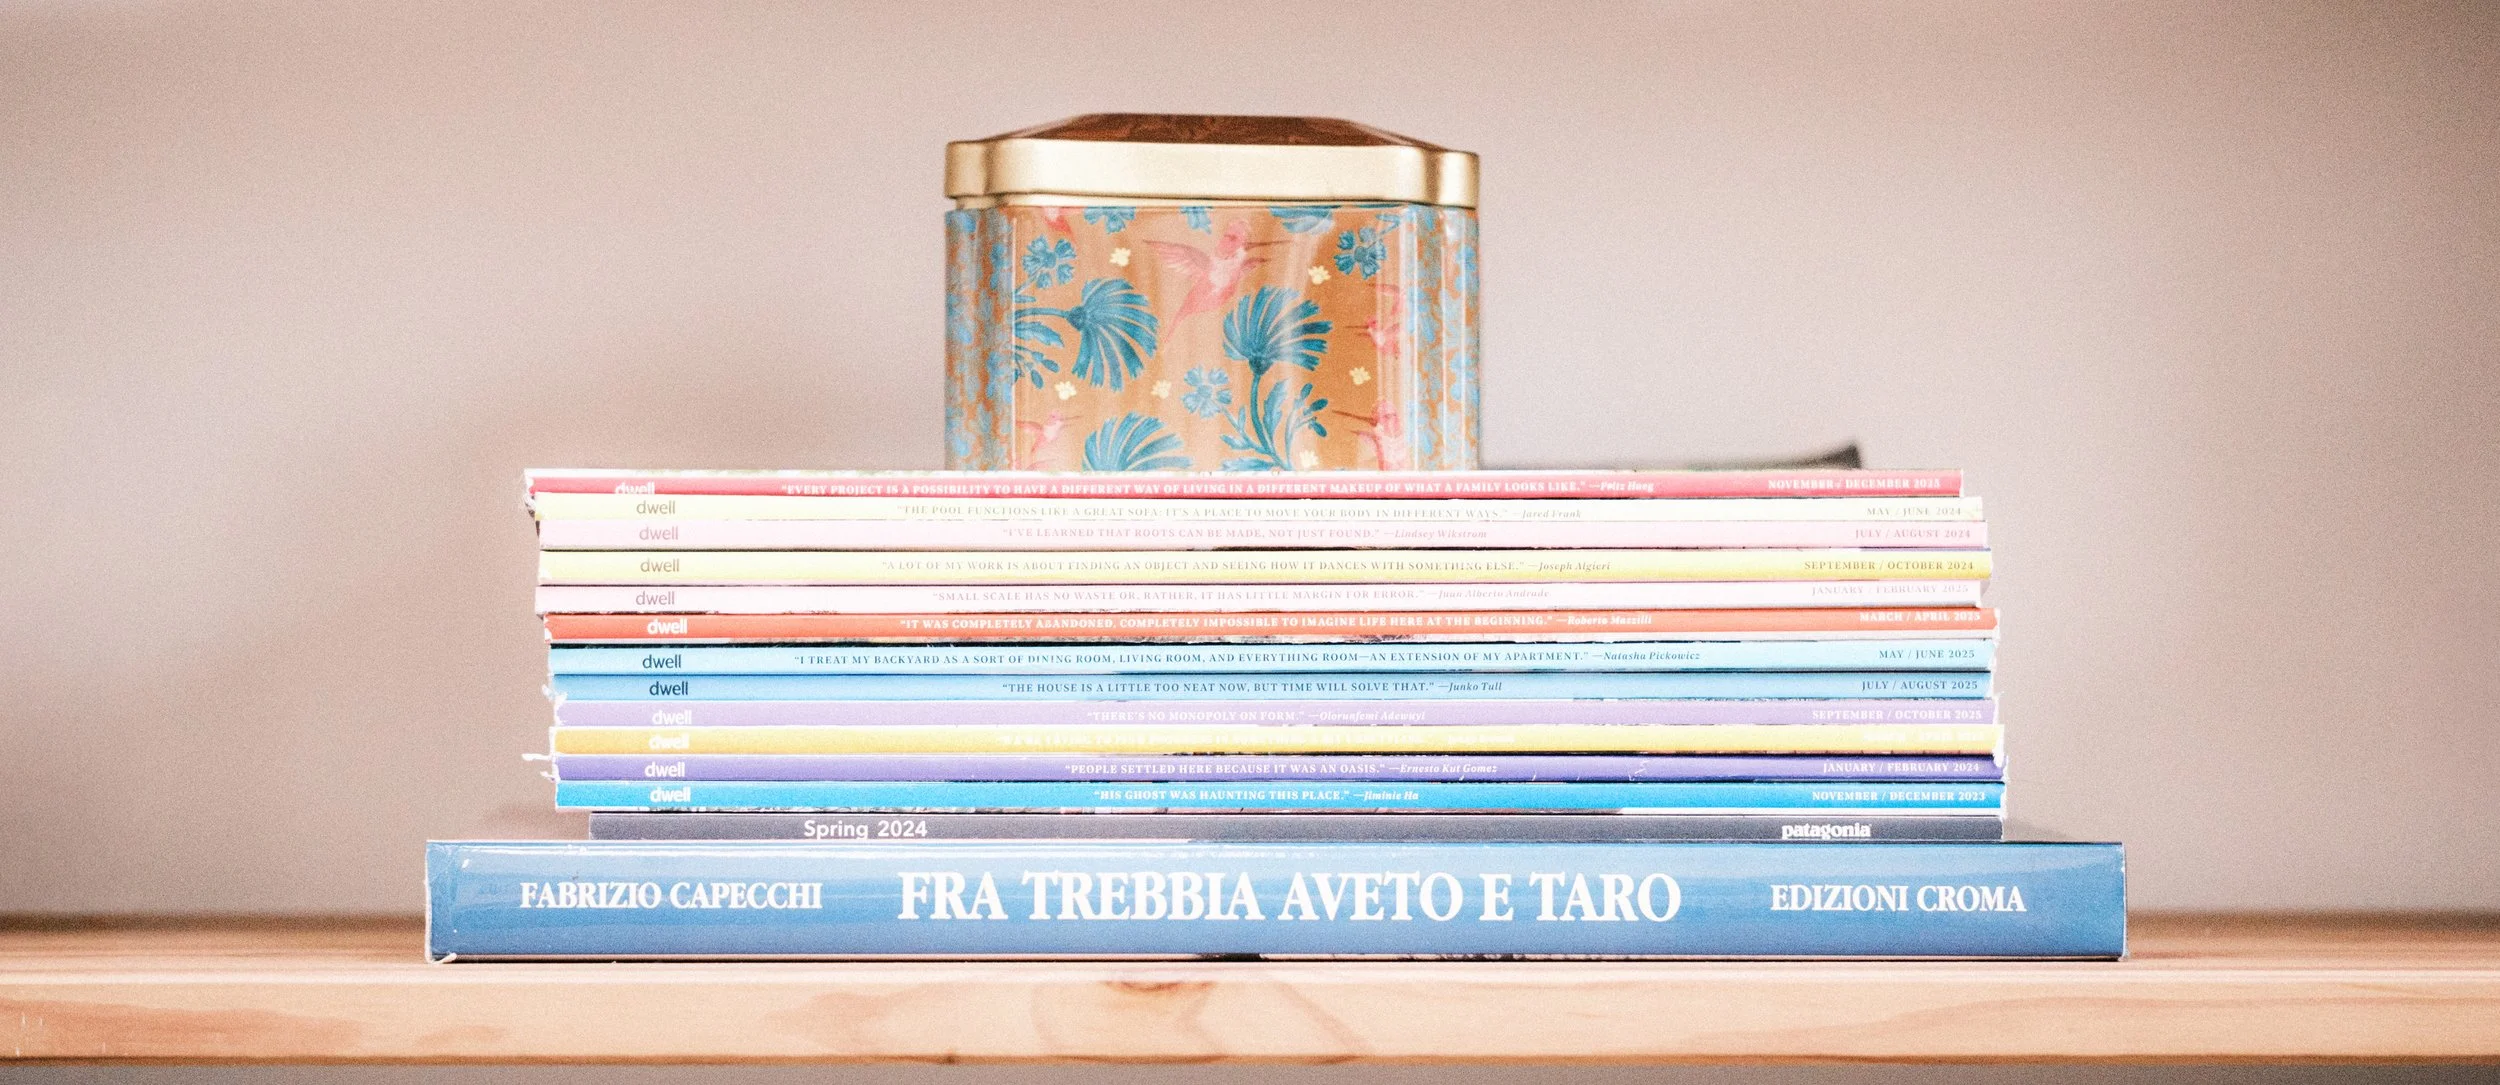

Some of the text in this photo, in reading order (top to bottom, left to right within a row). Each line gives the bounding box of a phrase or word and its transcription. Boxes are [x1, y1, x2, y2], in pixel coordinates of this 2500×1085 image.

[830, 485, 883, 494] PROJECT
[886, 485, 899, 494] IS
[902, 485, 909, 494] A
[913, 485, 991, 494] POSSIBILITY
[994, 485, 1010, 494] TO
[1013, 485, 1048, 494] HAVE
[1051, 485, 1058, 494] A
[1061, 484, 1131, 494] DIFFERENT
[1133, 484, 1161, 494] WAY
[1163, 484, 1180, 494] OF
[1183, 484, 1226, 493] LIVING
[1229, 483, 1243, 493] IN
[1246, 483, 1253, 493] A
[1257, 483, 1326, 493] DIFFERENT
[1330, 483, 1382, 493] MAKEUP
[1385, 483, 1401, 493] OF
[1404, 483, 1441, 492] WHAT
[1445, 483, 1452, 492] A
[1456, 482, 1501, 492] FAMILY
[1504, 482, 1544, 492] LOOKS
[1768, 479, 1834, 489] NOVEMBER
[1845, 479, 1910, 489] DECEMBER
[1913, 479, 1940, 488] 2025
[635, 500, 676, 514] dwell
[638, 526, 679, 540] dwell
[640, 559, 681, 573] dwell
[1804, 561, 1876, 570] SEPTEMBER
[1887, 561, 1943, 570] OCTOBER
[1947, 561, 1973, 570] 2024
[635, 590, 676, 606] dwell
[922, 619, 949, 629] WAS
[952, 619, 1032, 629] COMPLETELY
[1035, 619, 1117, 630] ABANDONED,
[1120, 618, 1200, 628] COMPLETELY
[1203, 618, 1278, 627] IMPOSSIBLE
[1281, 617, 1298, 627] TO
[1301, 617, 1356, 627] IMAGINE
[1359, 616, 1387, 626] LIFE
[1389, 616, 1423, 626] HERE
[1426, 616, 1441, 626] AT
[1445, 616, 1471, 626] THE
[1610, 615, 1652, 625] Mazzilli
[1859, 612, 1903, 621] MARCH
[1914, 612, 1950, 621] APRIL
[1954, 612, 1981, 621] 2025
[647, 617, 688, 634] dwell
[641, 653, 682, 668] dwell
[808, 655, 848, 665] TREAT
[852, 655, 871, 665] MY
[874, 655, 940, 665] BACKYARD
[943, 655, 958, 664] AS
[962, 655, 969, 664] A
[973, 655, 1005, 664] SORT
[1008, 655, 1024, 664] OF
[1028, 655, 1072, 664] DINING
[1075, 654, 1116, 665] ROOM,
[1119, 654, 1162, 663] LIVING
[1166, 654, 1205, 664] ROOM,
[1209, 653, 1235, 663] AND
[1239, 653, 1318, 662] EVERYTHING
[1390, 652, 1460, 662] EXTENSION
[1463, 652, 1480, 661] OF
[1482, 652, 1501, 661] MY
[1649, 652, 1701, 661] Pickowicz
[1879, 650, 1904, 659] MAY
[1915, 650, 1945, 660] JUNE
[1948, 650, 1975, 659] 2025
[648, 680, 689, 695] dwell
[1037, 683, 1078, 693] HOUSE
[1081, 683, 1093, 693] IS
[1096, 683, 1104, 693] A
[1108, 683, 1151, 693] LITTLE
[1154, 683, 1180, 692] TOO
[1183, 683, 1216, 692] NEAT
[1219, 683, 1250, 694] NOW,
[1254, 683, 1278, 692] BUT
[1281, 683, 1312, 692] TIME
[1316, 683, 1348, 692] WILL
[1351, 682, 1389, 692] SOLVE
[1481, 682, 1502, 691] Tull
[1862, 680, 1889, 691] JULY
[1900, 680, 1947, 690] AUGUST
[1951, 680, 1978, 690] 2025
[651, 709, 693, 724] dwell
[1148, 711, 1165, 721] NO
[1168, 711, 1236, 721] MONOPOLY
[1239, 711, 1257, 721] ON
[1812, 710, 1883, 720] SEPTEMBER
[1895, 710, 1951, 720] OCTOBER
[1954, 710, 1982, 720] 2025
[644, 760, 686, 777] dwell
[1121, 764, 1176, 773] SETTLED
[1179, 764, 1212, 773] HERE
[1215, 764, 1270, 773] BECAUSE
[1274, 764, 1287, 773] IT
[1290, 764, 1316, 773] WAS
[1320, 764, 1337, 773] AN
[1442, 763, 1460, 773] Kut
[1463, 763, 1497, 773] Gomez
[1823, 762, 1876, 773] JANUARY
[1887, 762, 1950, 772] FEBRUARY
[1953, 762, 1979, 772] 2024
[649, 786, 692, 802] dwell
[1124, 791, 1166, 800] GHOST
[1169, 791, 1196, 800] WAS
[1199, 791, 1265, 800] HAUNTING
[1268, 791, 1299, 800] THIS
[1812, 791, 1878, 801] NOVEMBER
[1890, 791, 1954, 801] DECEMBER
[1958, 791, 1985, 801] 2023
[804, 819, 928, 840] Spring 2024
[1781, 824, 1871, 840] patagonia
[520, 881, 823, 910] FABRIZIO CAPECCHI
[897, 872, 1682, 922] FRA TREBBIA AVETO E TARO
[1771, 884, 2026, 912] EDIZIONI CROMA
